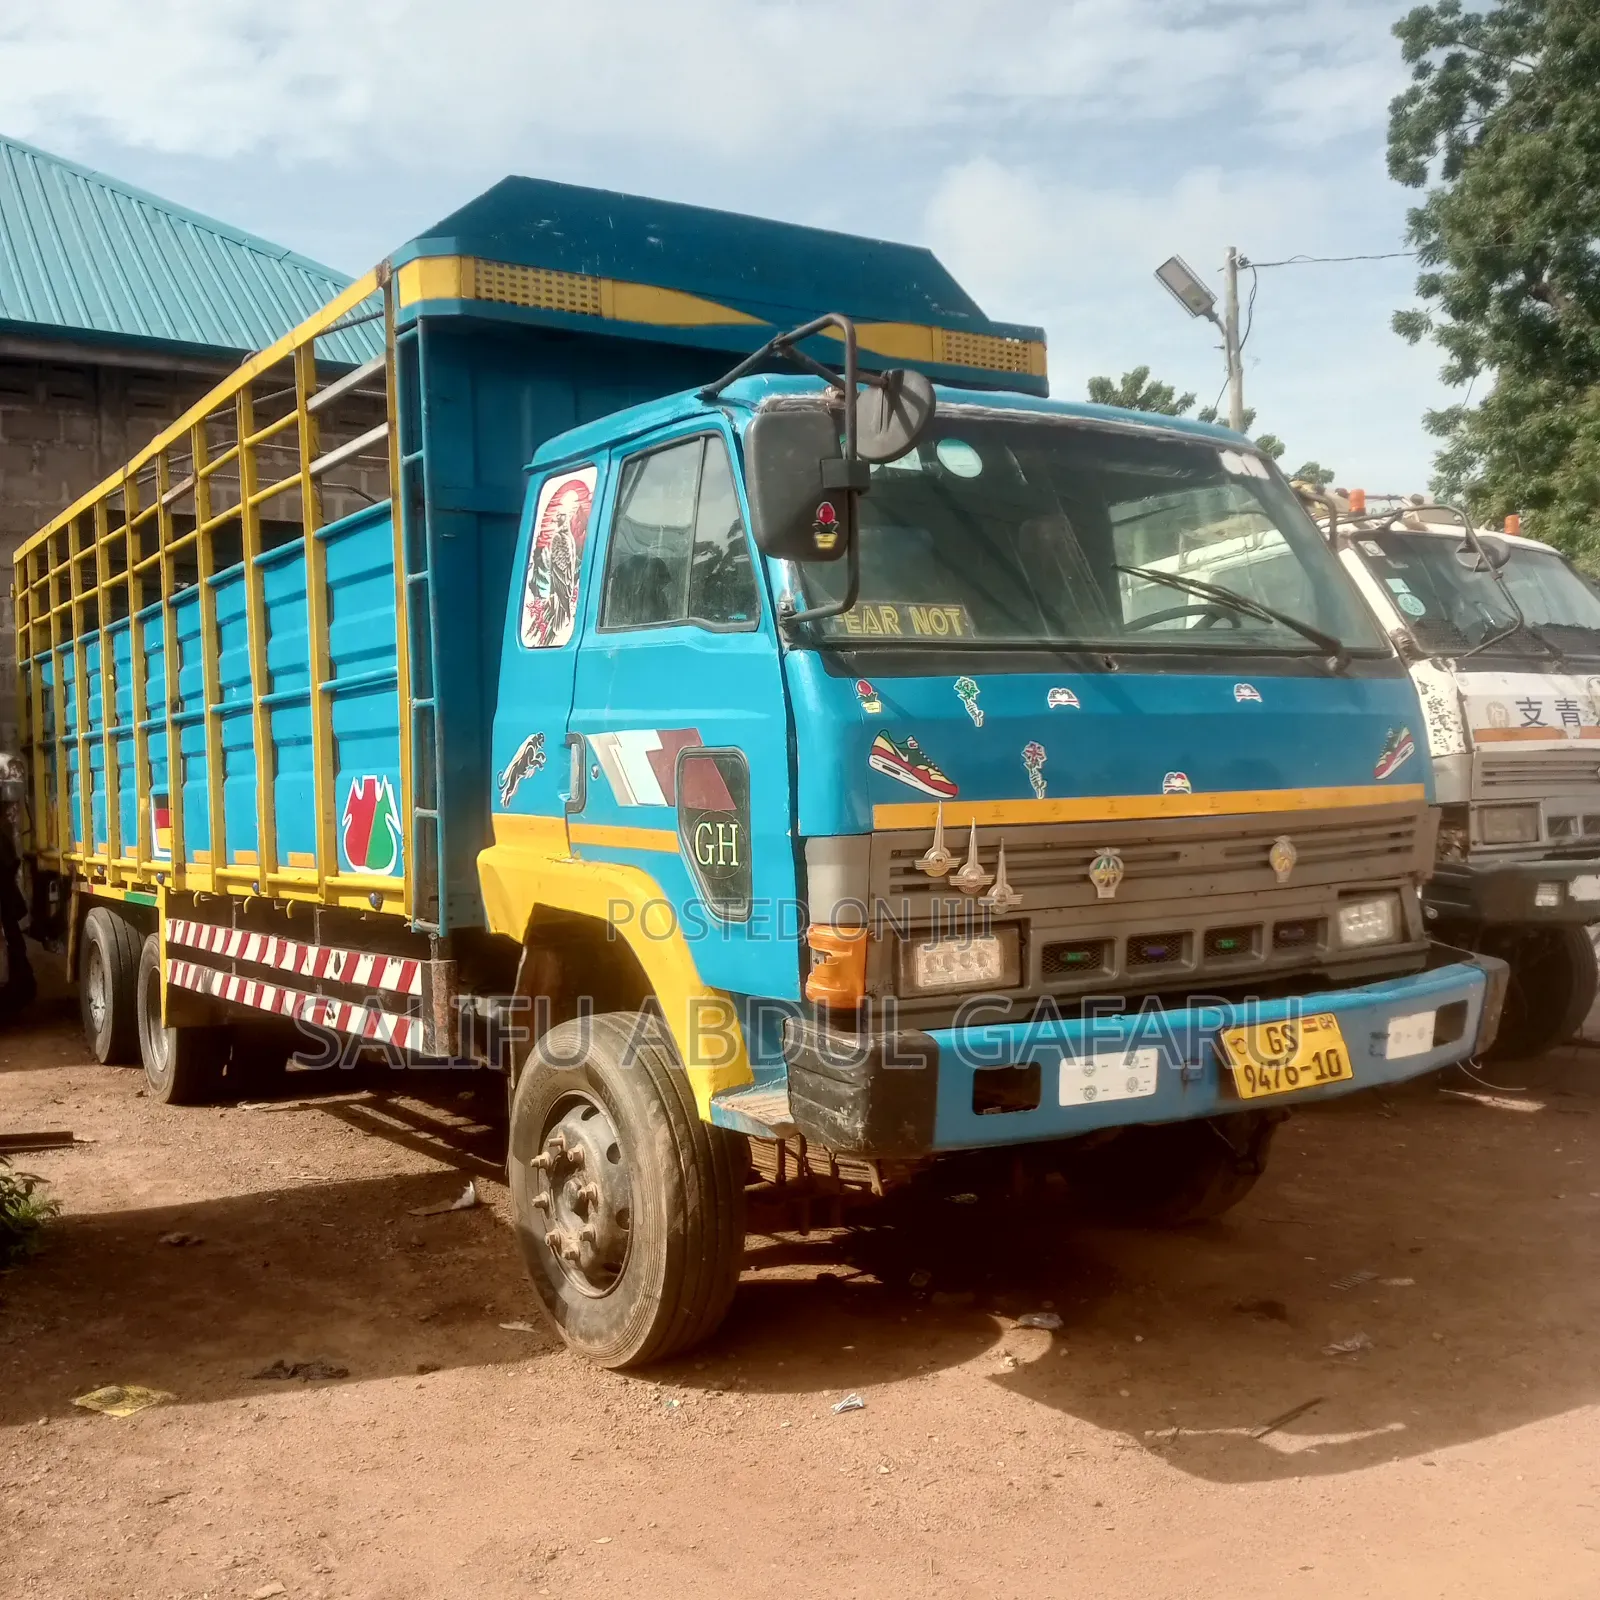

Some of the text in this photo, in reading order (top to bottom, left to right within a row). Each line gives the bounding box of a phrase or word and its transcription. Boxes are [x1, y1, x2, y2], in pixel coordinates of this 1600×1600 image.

[909, 606, 961, 636] NOT
[694, 821, 739, 867] GH
[1266, 1024, 1299, 1055] GS
[1243, 1048, 1343, 1093] 9476-10
